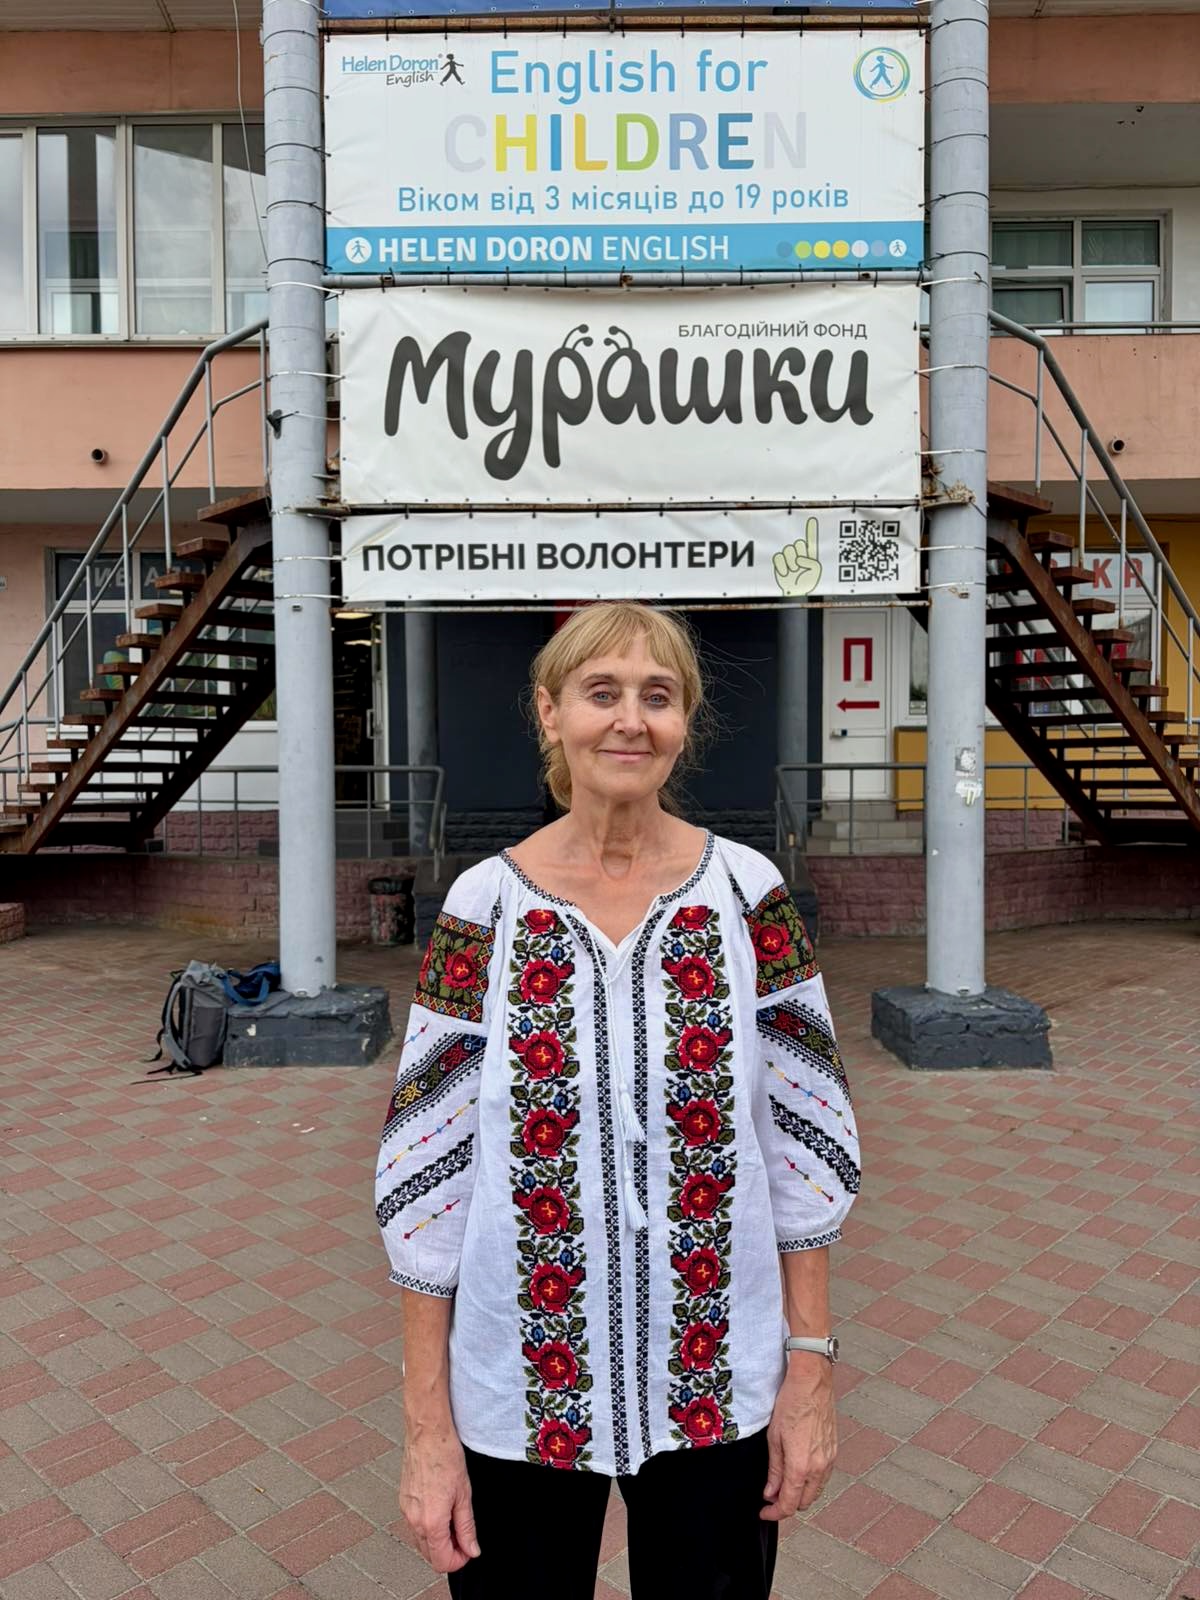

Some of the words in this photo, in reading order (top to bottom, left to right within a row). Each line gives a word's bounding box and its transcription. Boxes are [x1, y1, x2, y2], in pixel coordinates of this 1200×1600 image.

[342, 56, 387, 71] Helen
[389, 55, 439, 71] Doron
[490, 49, 676, 104] English
[696, 48, 769, 93] for
[386, 71, 434, 88] English
[446, 112, 807, 171] CHILDREN
[398, 186, 480, 212] Віком
[491, 186, 535, 215] від
[545, 185, 561, 211] 3
[571, 184, 679, 214] місяців
[689, 188, 725, 213] до
[735, 184, 762, 209] 19
[772, 183, 850, 214] років
[379, 238, 477, 262] HELEN
[486, 237, 593, 261] DORON
[602, 236, 730, 260] ENGLISH
[678, 321, 808, 339] БЛАГОДІЙНИЙ
[813, 324, 867, 339] ФОНД
[384, 324, 874, 480] Мурашки
[363, 543, 526, 571] ПОТРІБНІ
[537, 541, 755, 570] ВОЛОНТЕРИ
[843, 638, 873, 682] П
